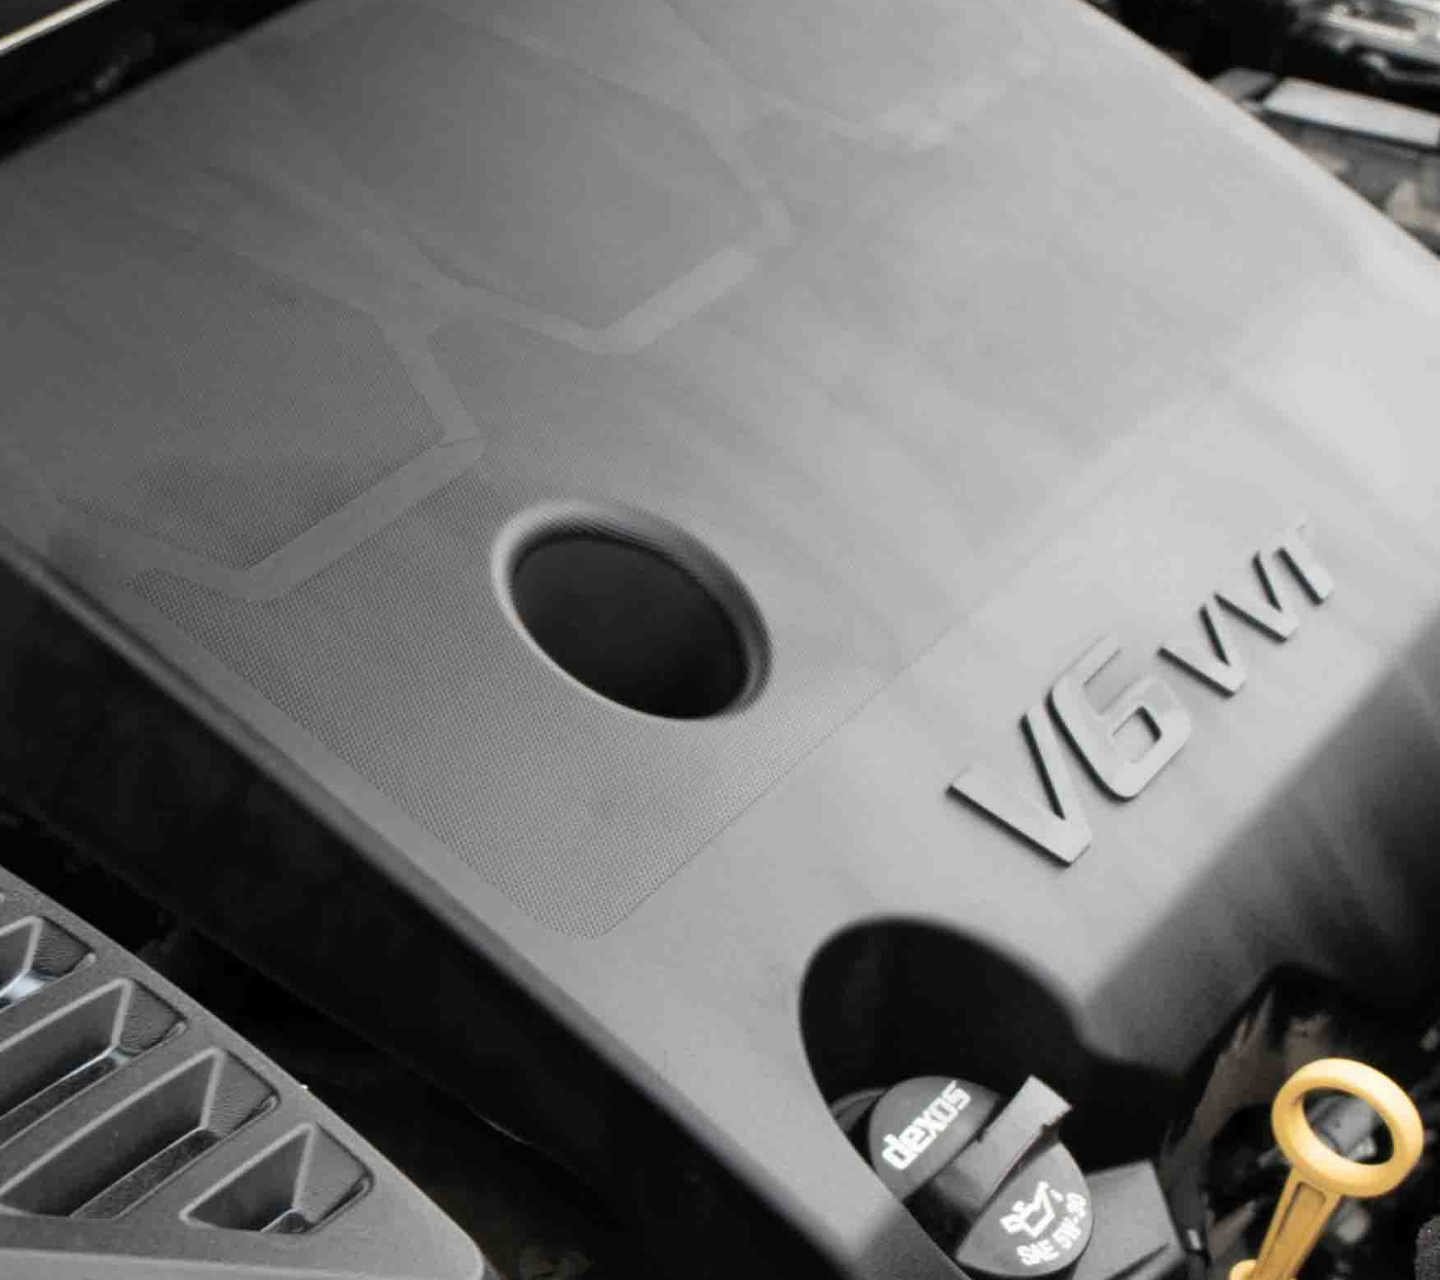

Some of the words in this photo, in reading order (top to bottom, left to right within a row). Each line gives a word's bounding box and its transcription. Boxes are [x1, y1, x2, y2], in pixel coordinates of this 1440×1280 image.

[946, 630, 1193, 868] V6
[881, 1079, 971, 1171] dexos
[1016, 1239, 1060, 1266] SAE
